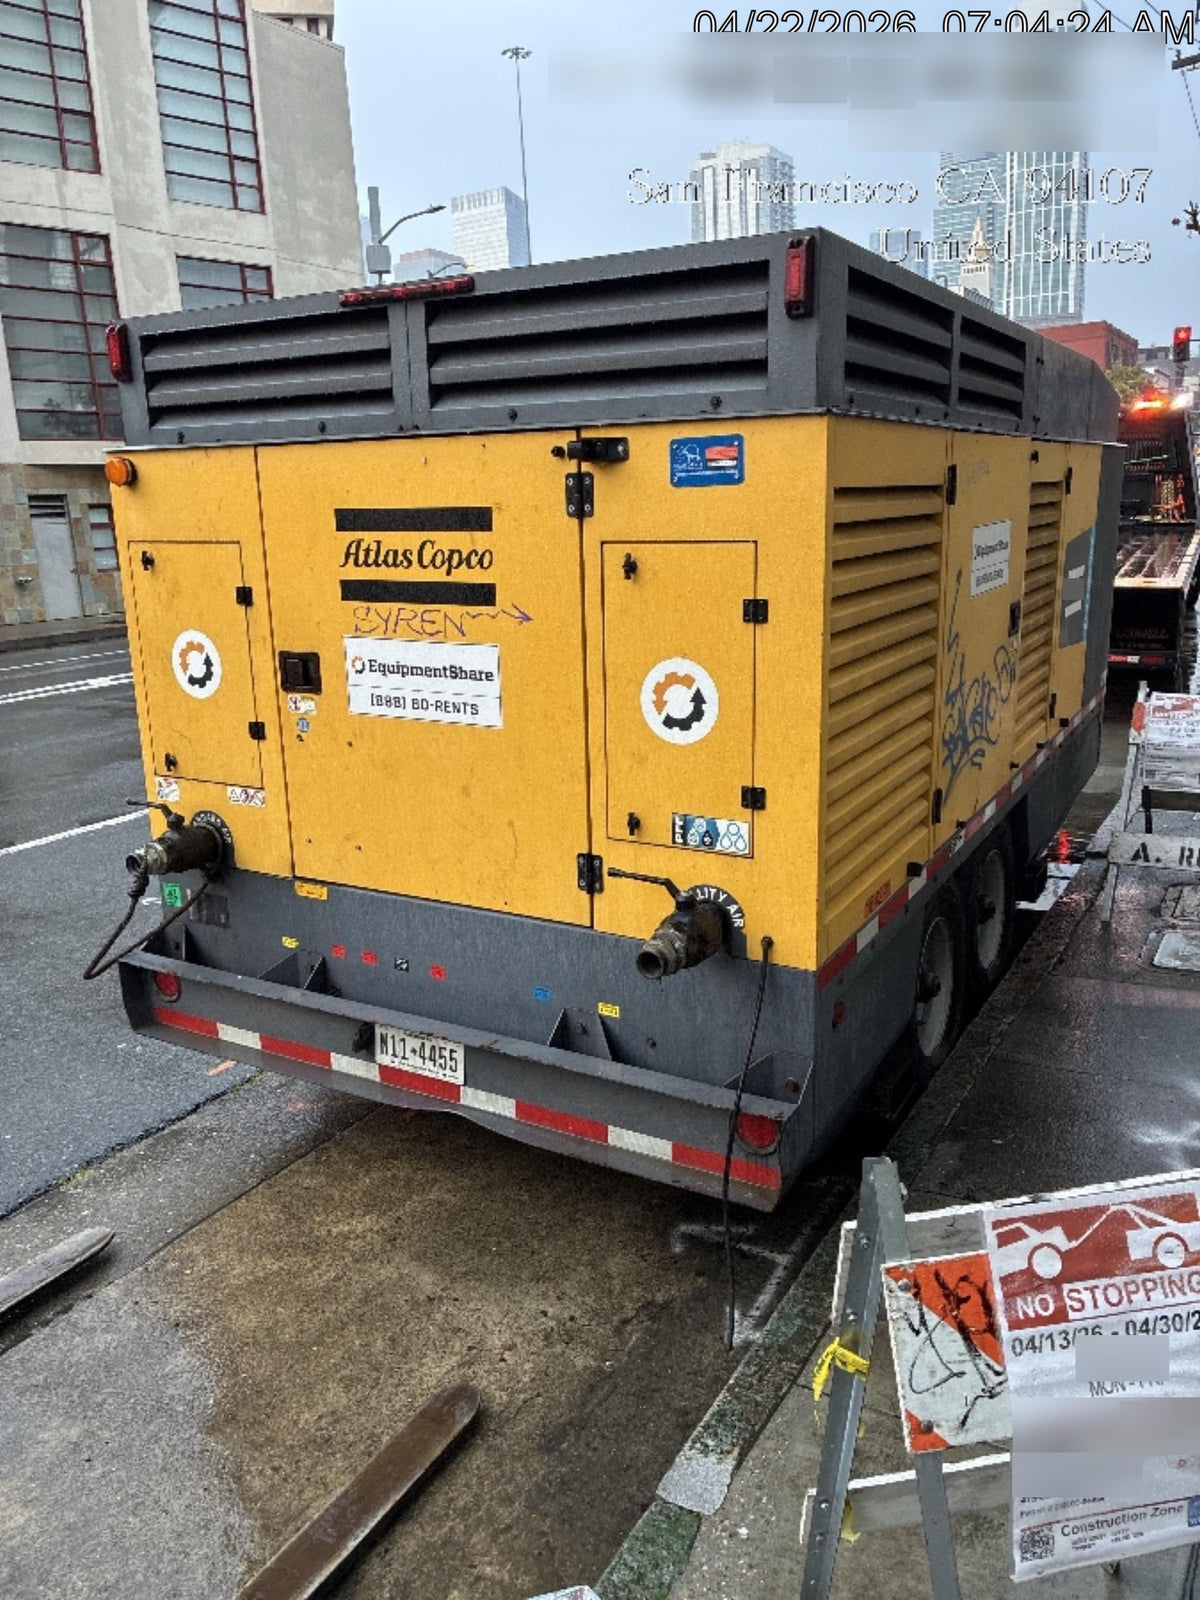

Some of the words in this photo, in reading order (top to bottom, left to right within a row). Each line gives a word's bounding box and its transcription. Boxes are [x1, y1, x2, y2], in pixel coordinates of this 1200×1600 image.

[339, 537, 413, 569] Atlas
[417, 539, 494, 577] Copco
[367, 658, 495, 682] EquipmentShare
[726, 904, 744, 927] AIR
[1017, 1294, 1055, 1319] NO
[1060, 1511, 1147, 1537] Construction
[1150, 1505, 1184, 1518] Zone
